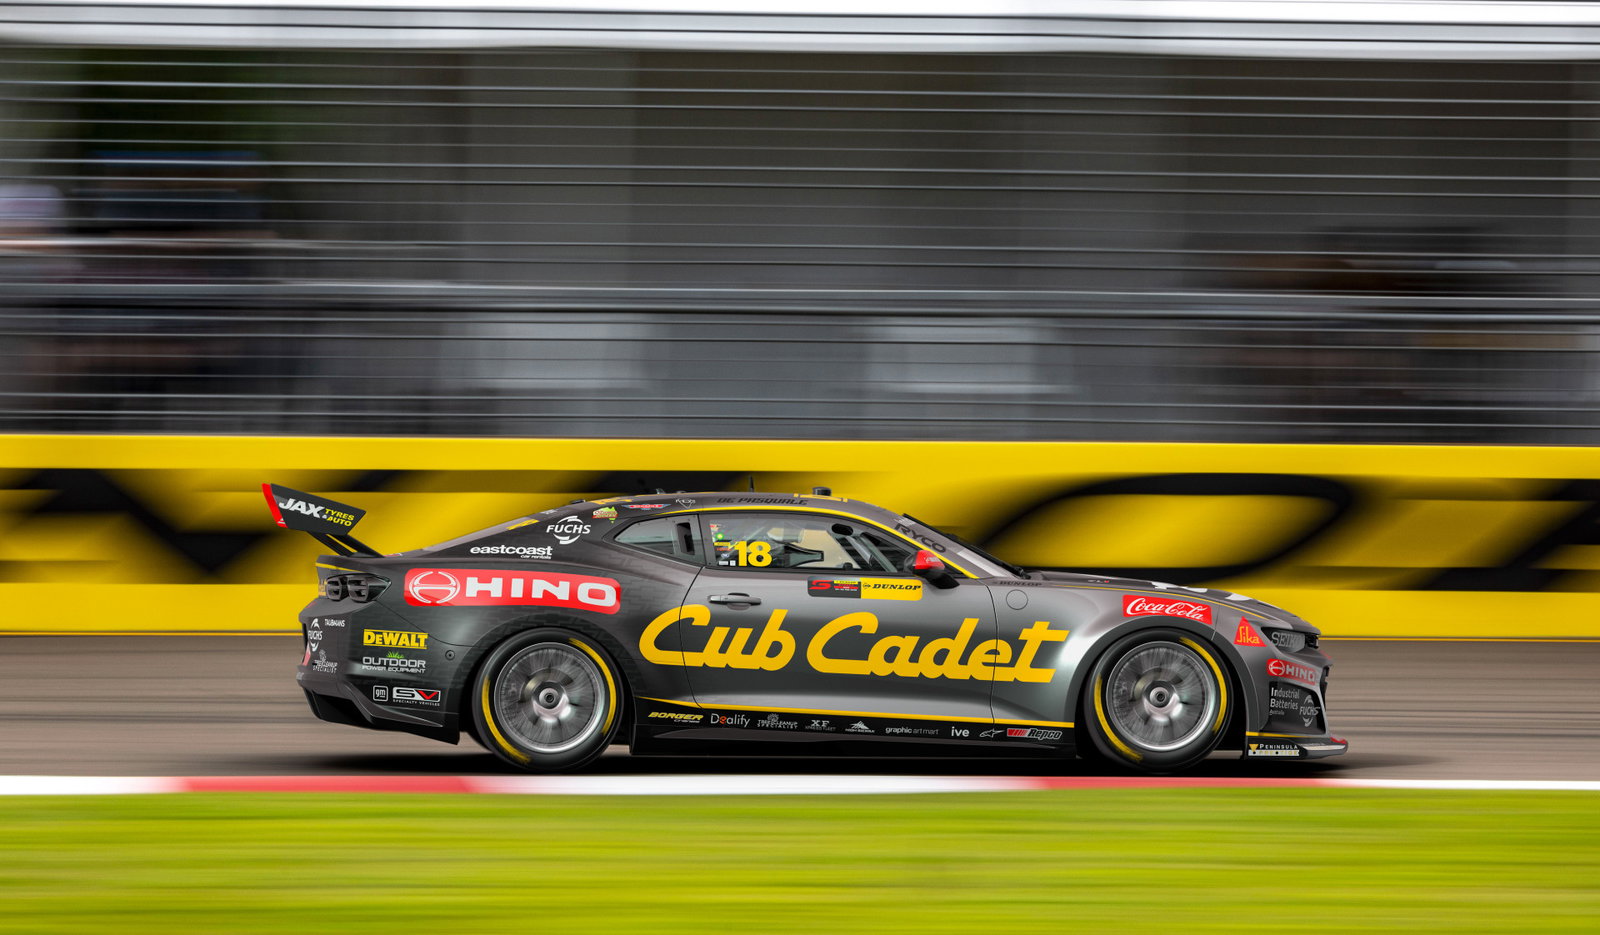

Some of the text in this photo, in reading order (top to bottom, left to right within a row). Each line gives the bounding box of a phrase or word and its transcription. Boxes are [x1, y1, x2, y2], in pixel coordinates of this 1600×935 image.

[278, 498, 325, 518] JAX
[325, 508, 355, 521] TYRES
[326, 516, 352, 527] AUTO
[546, 523, 591, 535] FUCHS
[895, 523, 946, 553] RYCO
[470, 544, 553, 557] eastcoast
[734, 540, 772, 567] 18
[465, 576, 617, 607] HINO
[872, 583, 922, 591] DUNLOP
[1126, 597, 1207, 620] Coca-Cola
[308, 630, 323, 641] FUCHS
[1237, 626, 1260, 644] Sika
[1271, 632, 1304, 648] SEIK
[639, 604, 1070, 683] Cub Cadet
[362, 656, 426, 668] OUTDOOR
[1285, 664, 1315, 682] HINO
[375, 689, 386, 698] gm
[1271, 687, 1300, 699] Industrial
[1270, 698, 1299, 710] Batteries
[648, 711, 704, 720] BORGER
[1300, 706, 1320, 716] FUCHS
[710, 713, 750, 728] Dealify
[885, 726, 912, 734] graphic
[951, 726, 970, 737] ive
[1027, 728, 1062, 740] Repco
